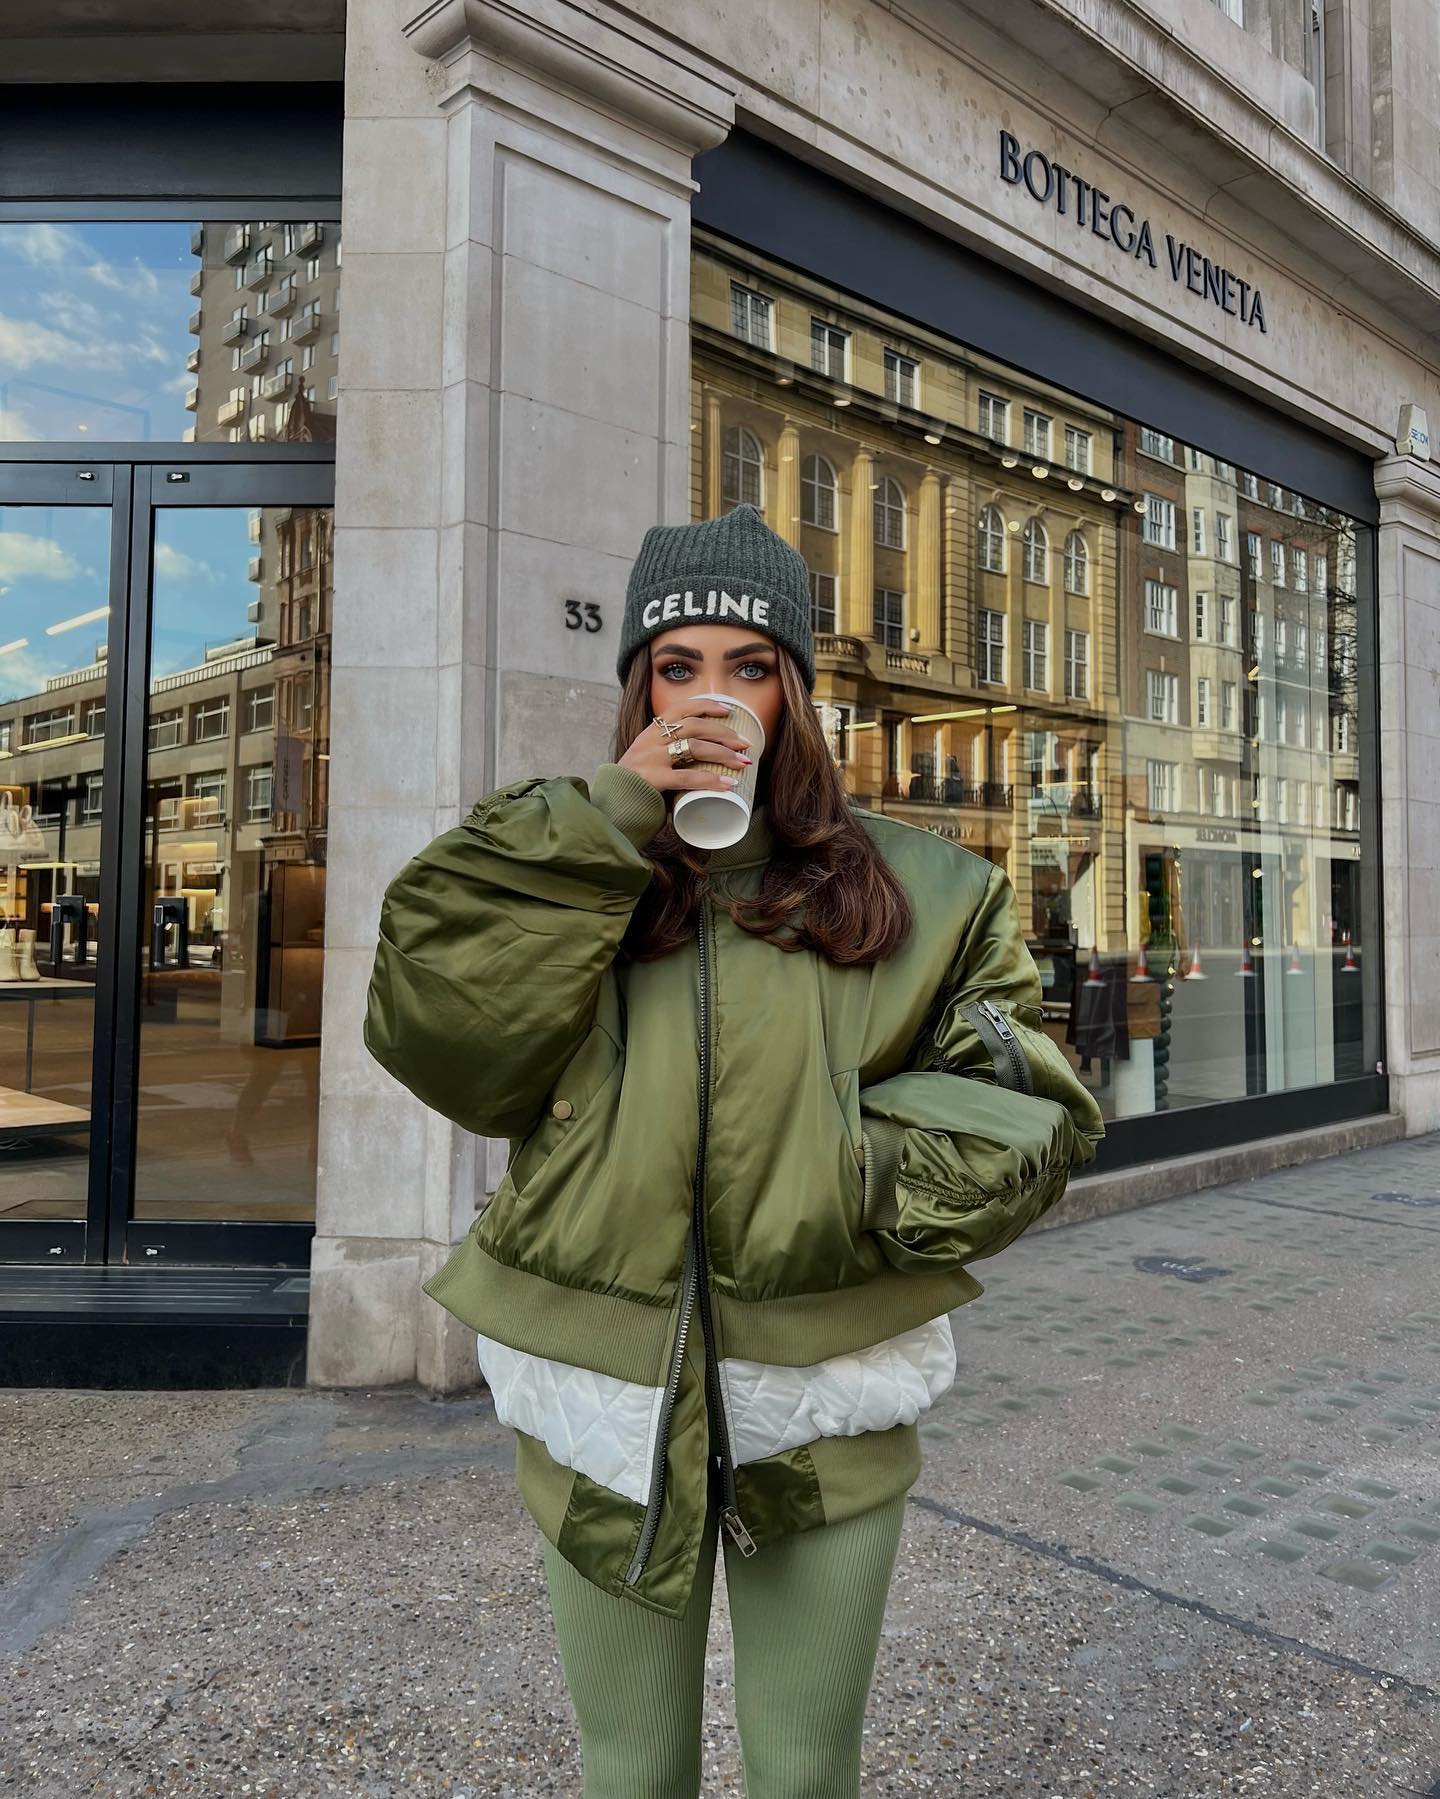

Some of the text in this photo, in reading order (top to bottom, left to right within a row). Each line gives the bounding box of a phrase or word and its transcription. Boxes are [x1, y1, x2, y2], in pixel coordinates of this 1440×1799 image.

[1000, 130, 1267, 333] BOTTEGA VENETA
[565, 600, 603, 632] 33
[643, 591, 769, 629] CELINE
